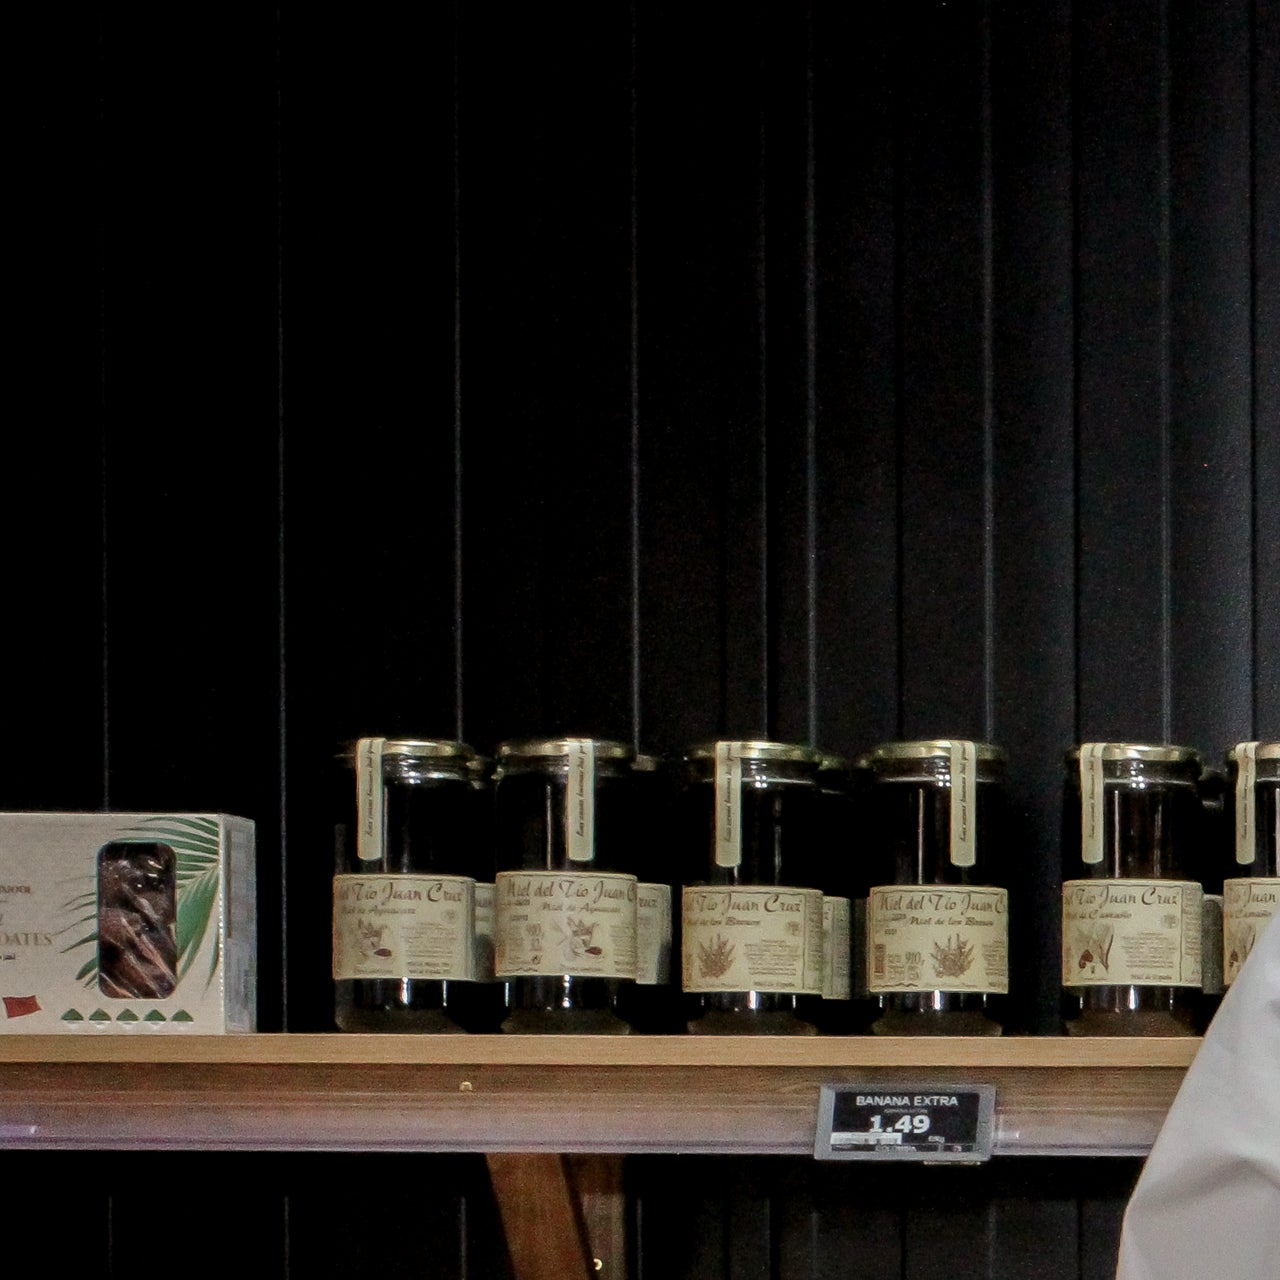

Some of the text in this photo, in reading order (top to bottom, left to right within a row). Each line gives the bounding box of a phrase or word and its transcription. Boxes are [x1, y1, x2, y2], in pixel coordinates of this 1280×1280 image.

[855, 1095, 959, 1107] BANANA EXTRA
[868, 1114, 931, 1134] 1.49
